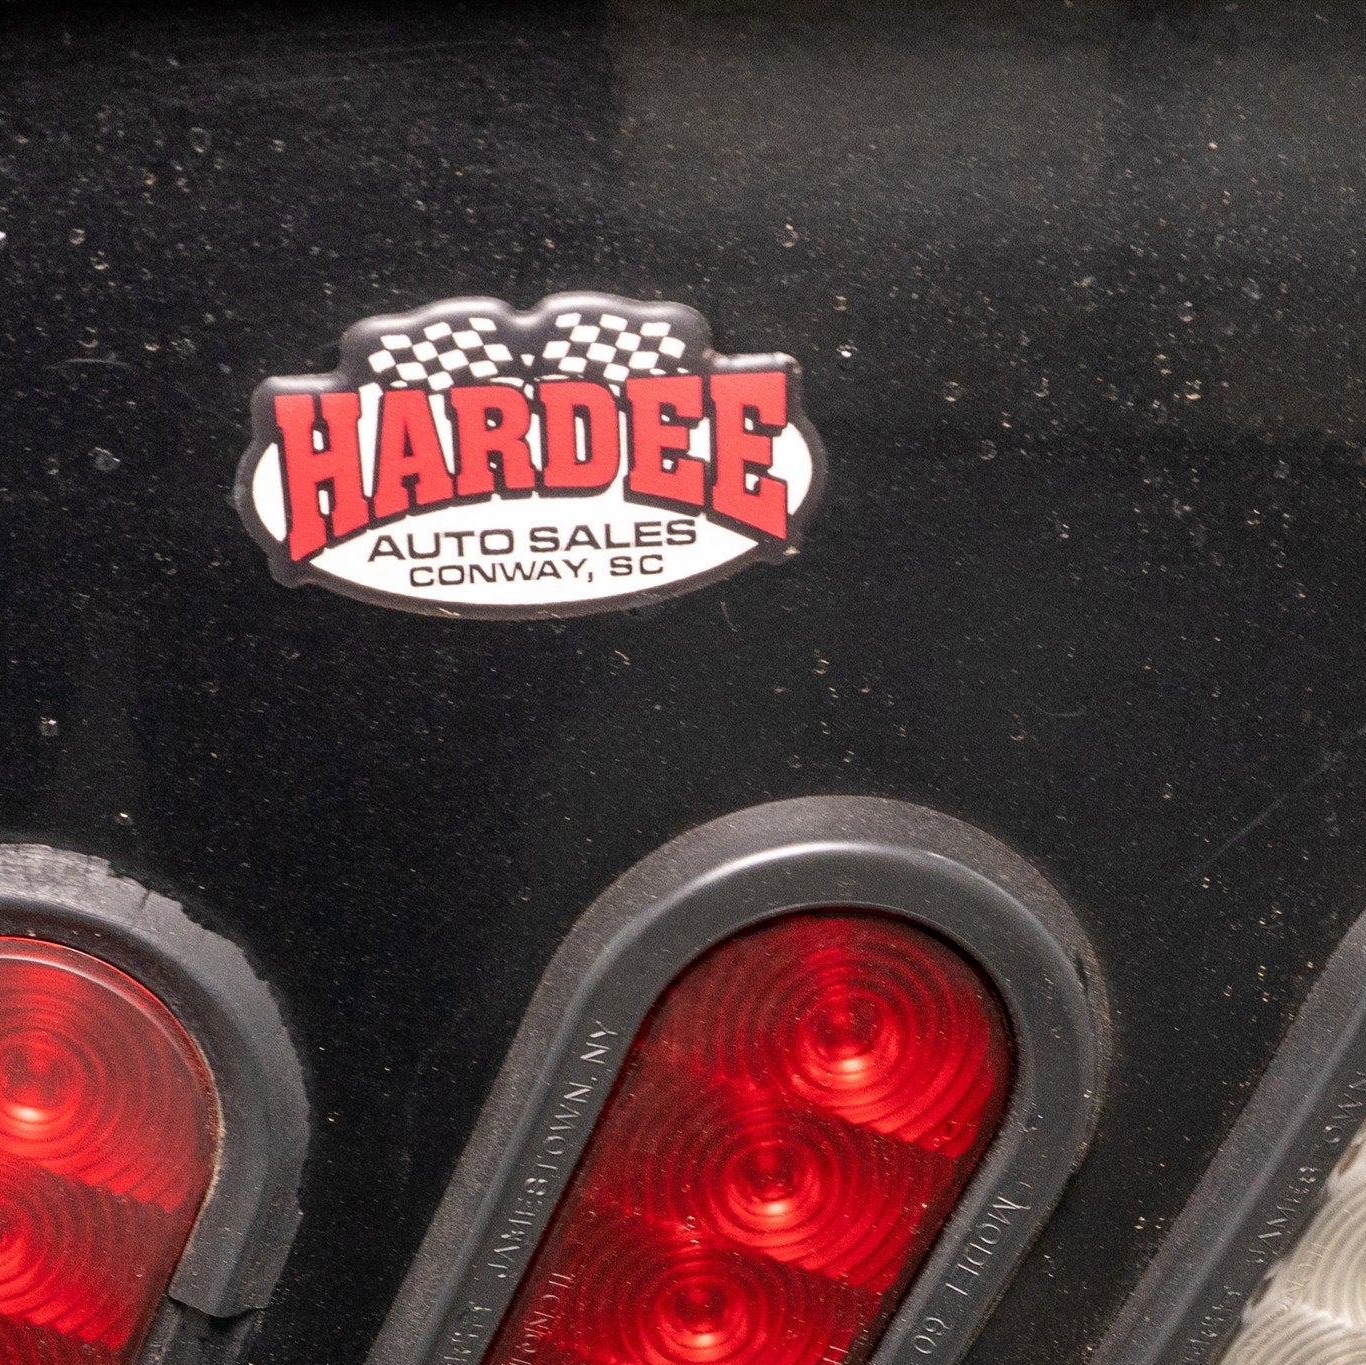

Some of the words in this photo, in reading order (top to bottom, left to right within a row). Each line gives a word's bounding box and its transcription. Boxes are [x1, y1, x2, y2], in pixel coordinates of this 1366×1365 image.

[273, 371, 788, 563] HARDEE
[368, 529, 515, 564] AUTO
[528, 518, 698, 552] SALES
[409, 558, 595, 588] CONWAY,
[609, 553, 665, 578] SC
